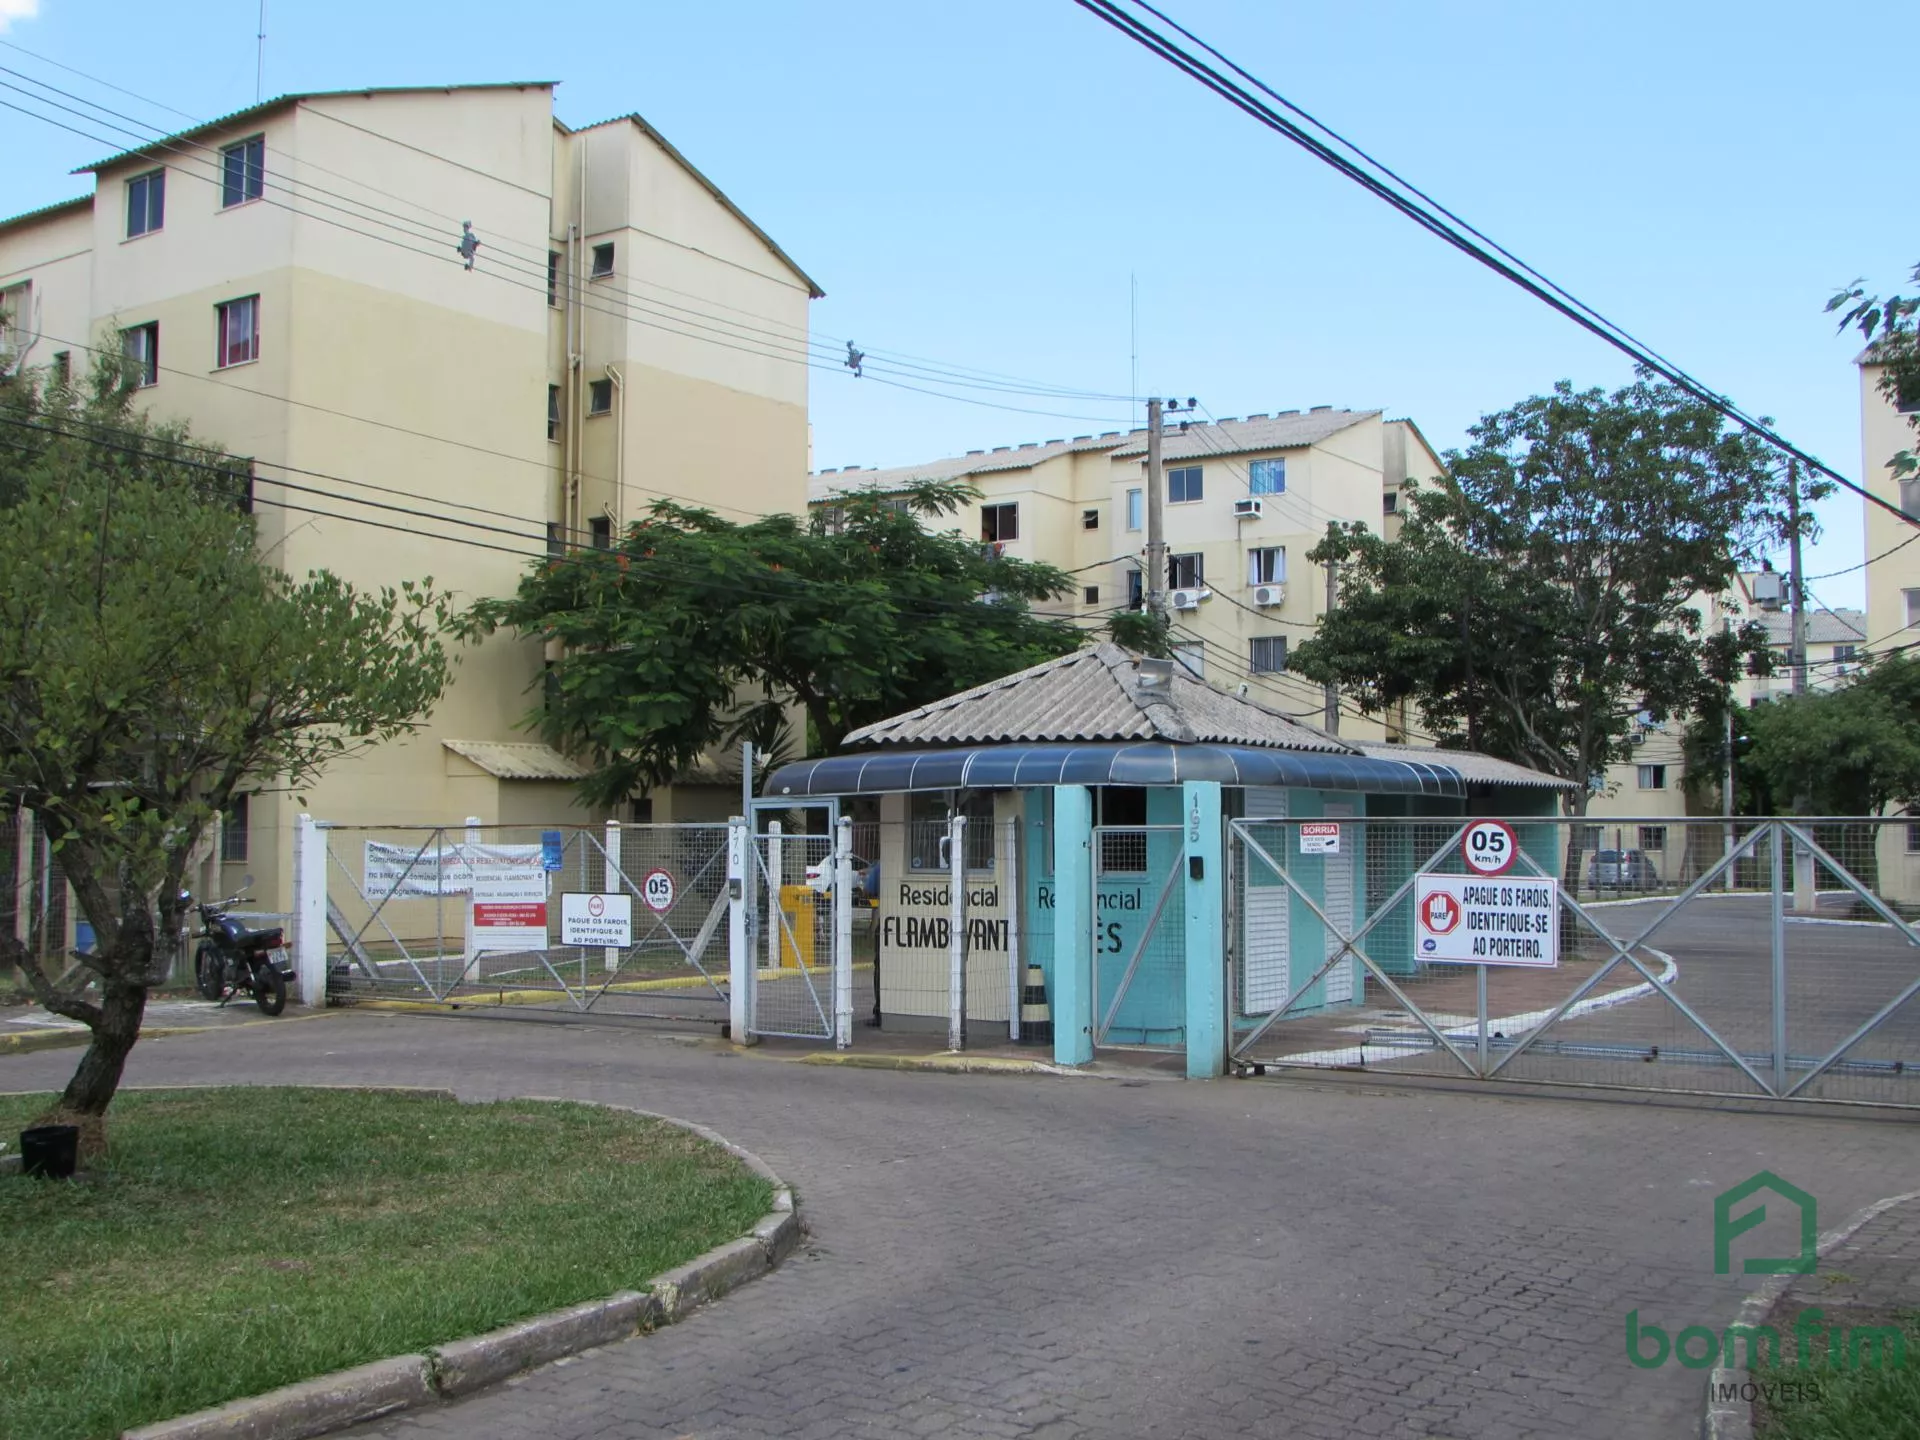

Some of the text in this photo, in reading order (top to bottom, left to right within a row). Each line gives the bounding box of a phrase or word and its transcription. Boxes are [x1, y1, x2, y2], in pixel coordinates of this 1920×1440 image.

[1302, 826, 1336, 834] SORRIA
[1471, 831, 1505, 853] 05
[1474, 854, 1502, 865] km/h
[649, 879, 669, 895] 05
[1463, 884, 1552, 911] APAGUE OS FARÓIS,
[1466, 911, 1549, 934] IDENTIFIQUE-SE
[1472, 936, 1543, 959] AO PORTEIRO.
